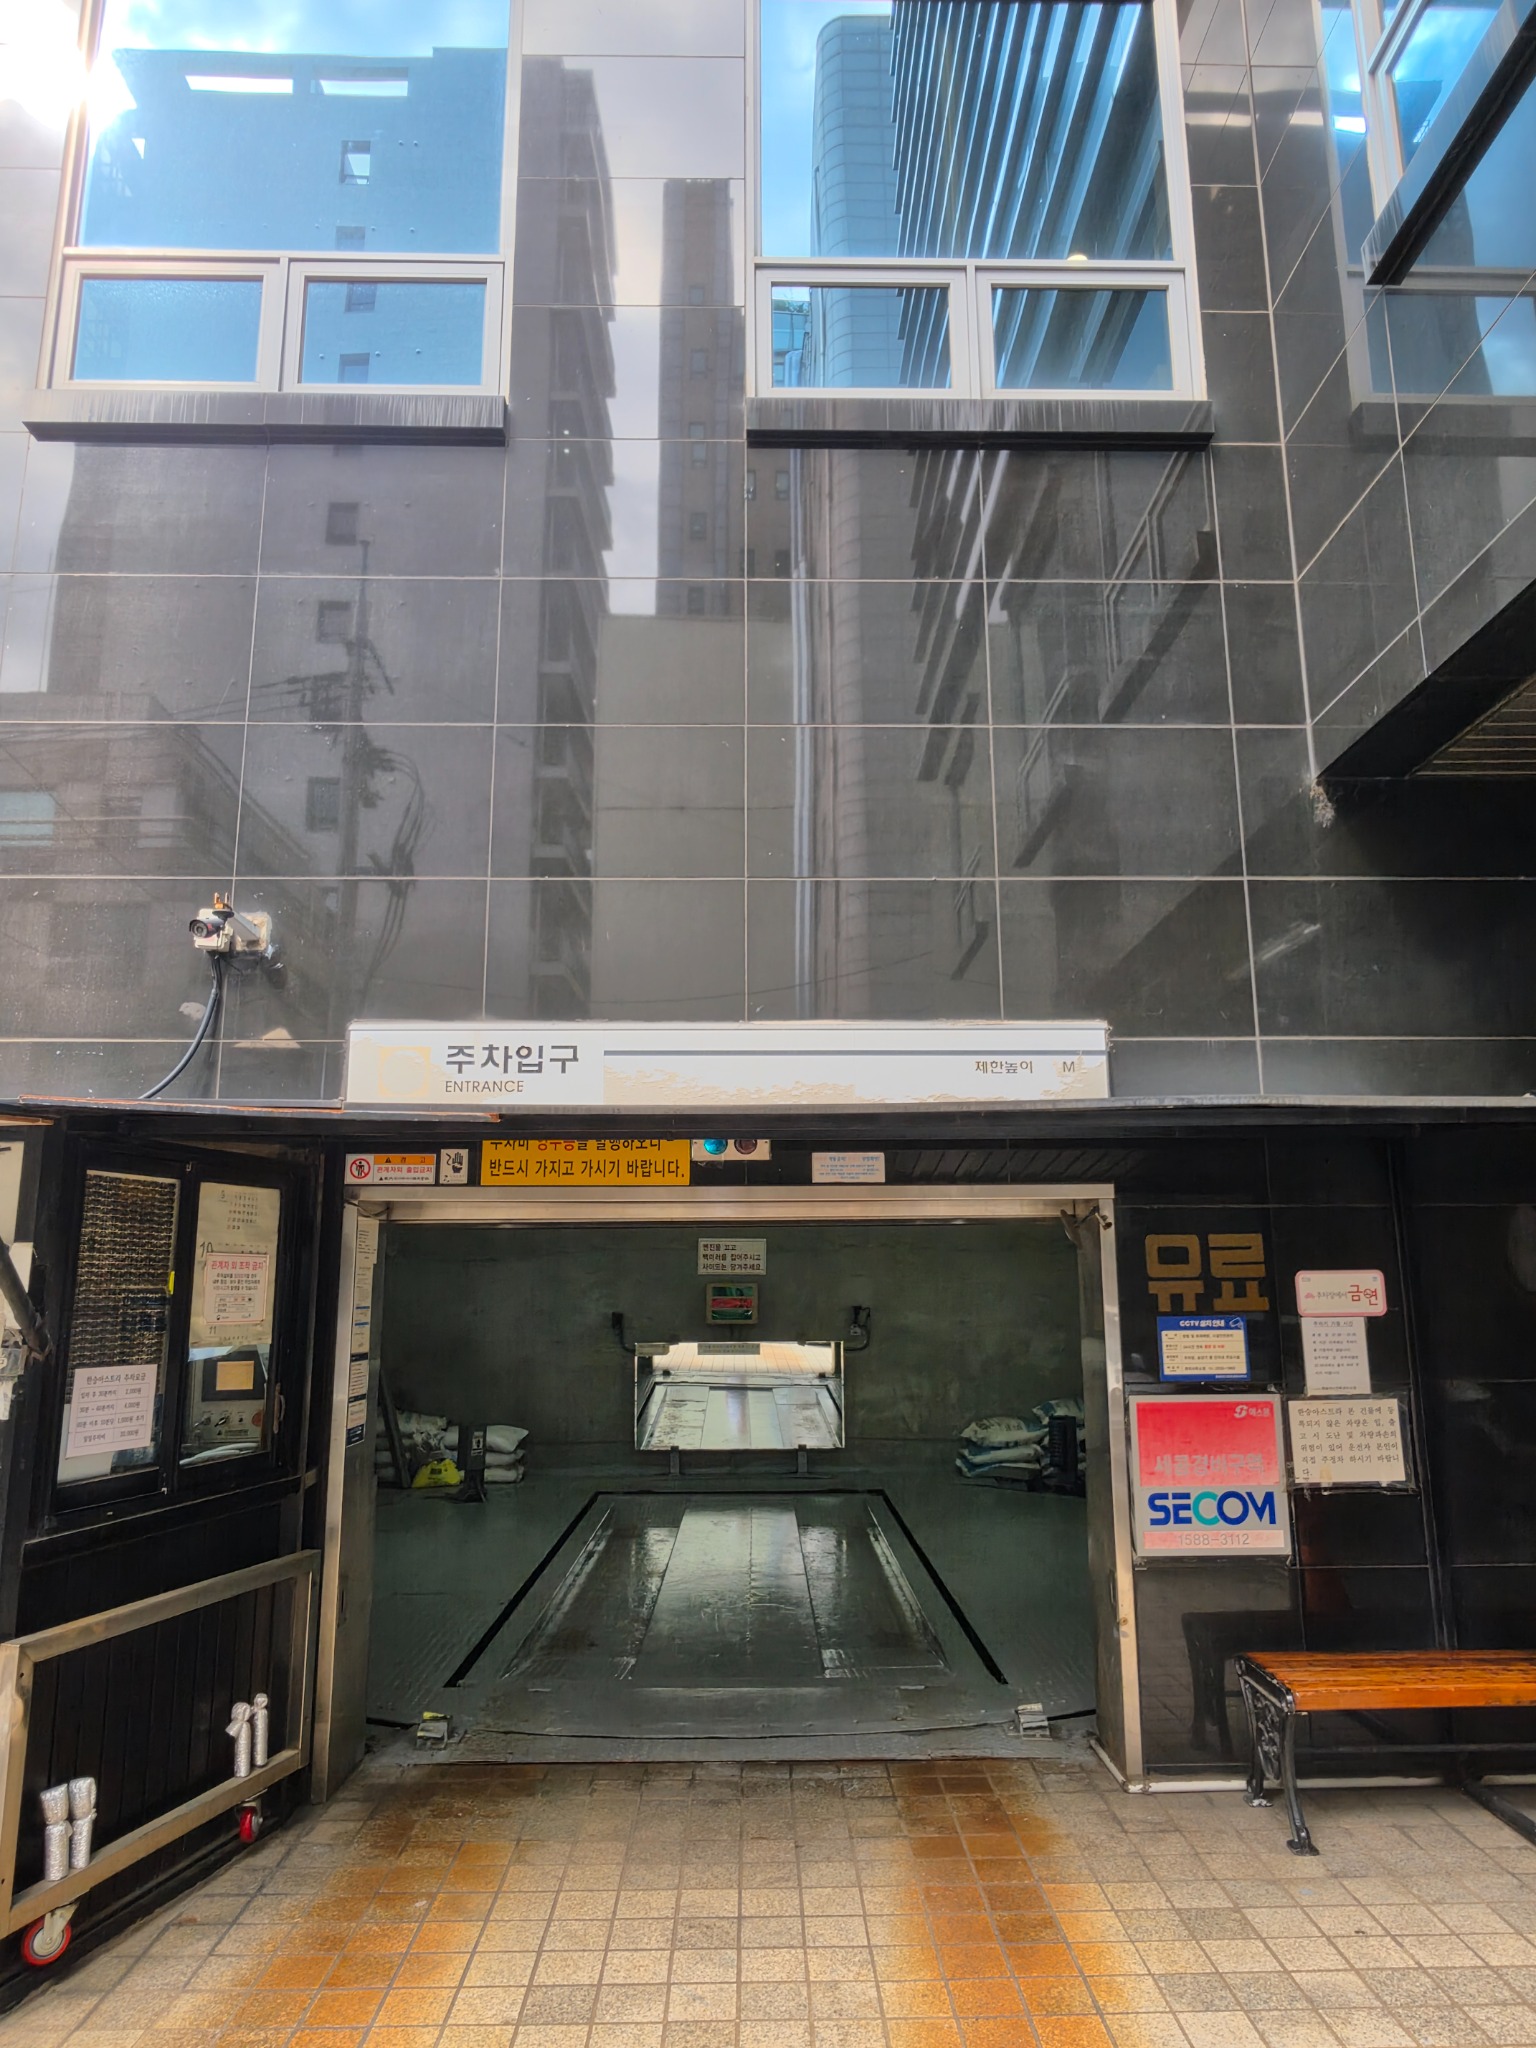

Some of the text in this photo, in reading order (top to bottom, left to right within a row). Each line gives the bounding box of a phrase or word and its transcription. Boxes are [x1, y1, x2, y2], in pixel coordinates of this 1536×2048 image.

[446, 1044, 579, 1074] 주차입구
[975, 1060, 1076, 1074] 제한높이 M
[445, 1080, 525, 1093] ENTRANCE
[489, 1159, 685, 1178] 반드시 가지고 가시기 바랍니다.
[1145, 1233, 1269, 1312] 유료
[1348, 1284, 1378, 1306] 금연
[1154, 1452, 1266, 1476] 세콤경비구역
[1148, 1490, 1276, 1526] SECOM
[1178, 1533, 1250, 1546] 1588-3112
